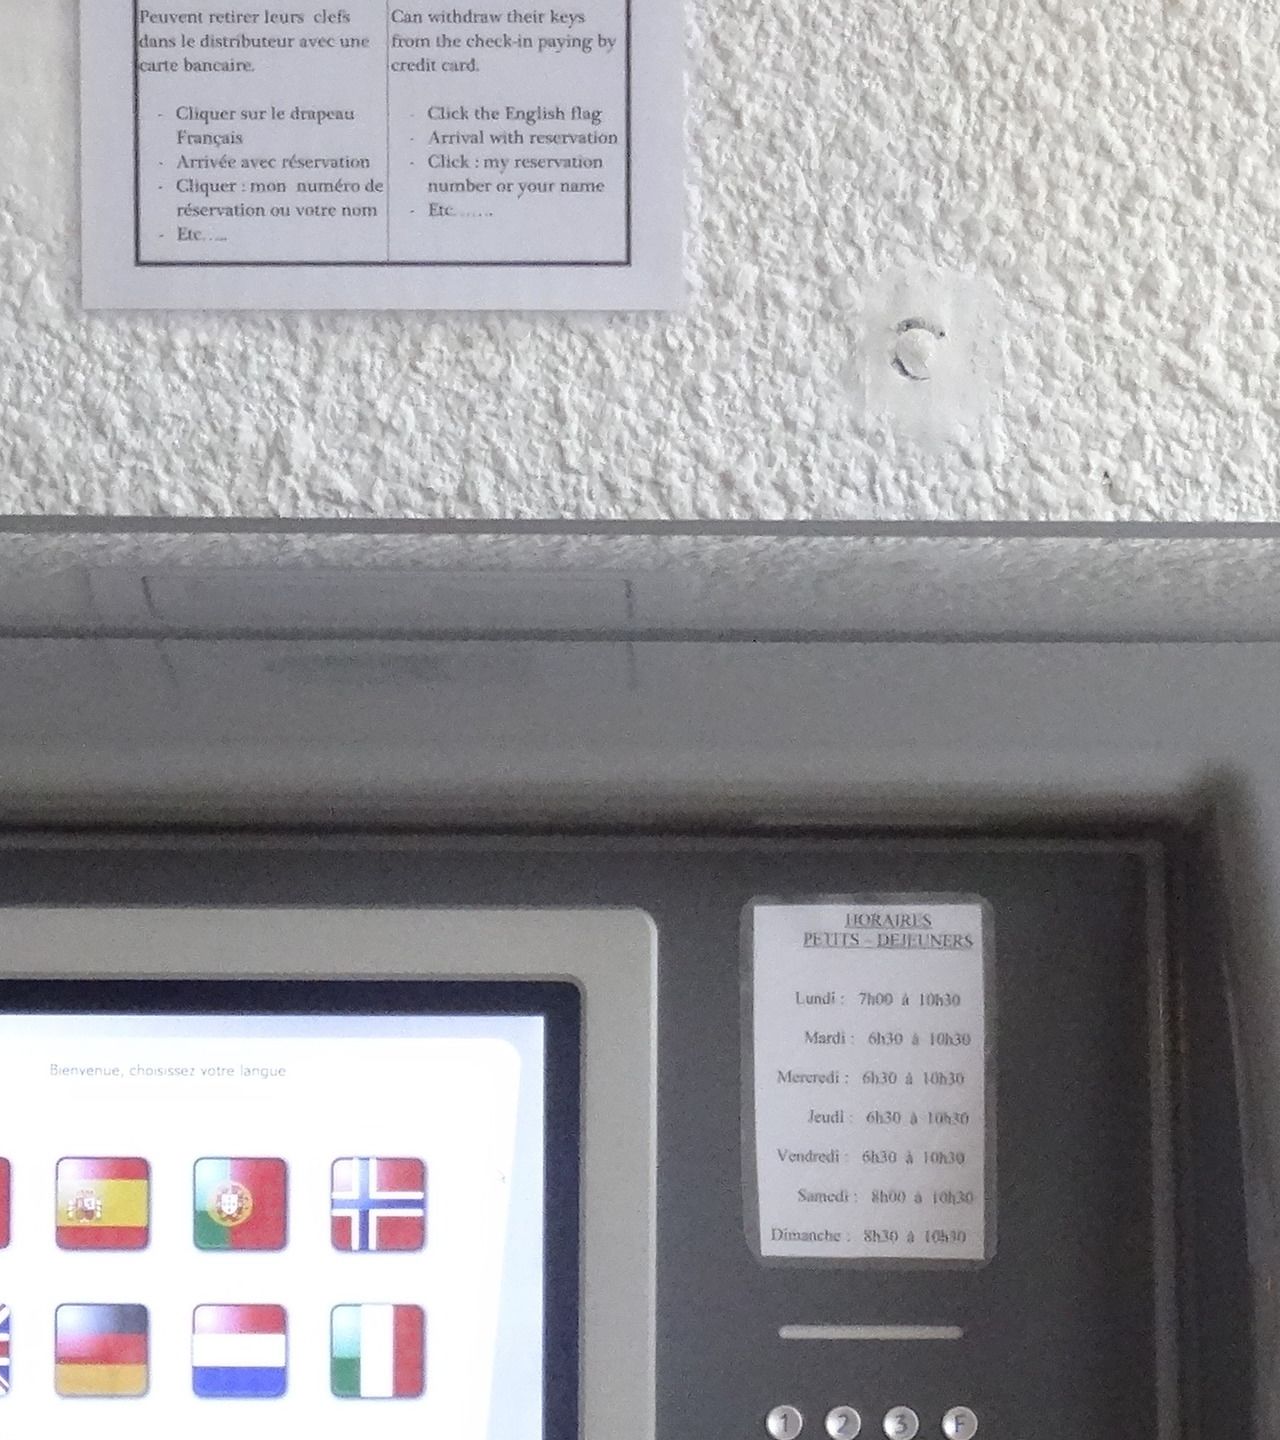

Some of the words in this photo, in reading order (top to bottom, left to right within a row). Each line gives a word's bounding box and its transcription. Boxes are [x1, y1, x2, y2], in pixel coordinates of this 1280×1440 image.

[139, 9, 203, 24] Peuvent
[209, 10, 259, 24] retirer
[265, 10, 305, 24] leurs
[313, 9, 351, 24] clefs
[391, 9, 422, 24] Can
[428, 9, 501, 24] withdraw
[507, 9, 545, 24] their
[550, 9, 586, 29] keys
[139, 34, 176, 49] dans
[181, 34, 195, 49] le
[200, 34, 295, 49] distributeur
[299, 37, 335, 49] avec
[339, 37, 370, 49] une
[391, 34, 431, 49] from
[436, 34, 461, 49] the
[466, 34, 533, 49] check-in
[538, 36, 593, 53] paying
[597, 34, 617, 54] by
[139, 60, 179, 73] carte
[183, 57, 255, 73] bancaire.
[390, 58, 436, 73] credit
[441, 58, 480, 73] card.
[176, 106, 236, 125] Cliquer
[240, 109, 267, 121] sur
[271, 106, 286, 121] le
[290, 106, 355, 125] drapeau
[427, 106, 469, 121] Click
[474, 106, 500, 121] the
[506, 106, 565, 126] English
[571, 106, 603, 126] flag
[176, 130, 243, 147] Français
[428, 130, 484, 145] Arrival
[489, 130, 525, 145] with
[529, 131, 618, 145] reservation
[176, 154, 237, 169] Arrivée
[240, 157, 277, 169] avec
[281, 154, 370, 169] réservation
[427, 154, 470, 169] Click
[483, 157, 508, 174] my
[514, 155, 604, 169] reservation
[176, 178, 237, 197] Cliquer
[249, 181, 287, 193] mon
[296, 179, 361, 193] numéro
[365, 178, 384, 193] de
[427, 178, 492, 193] number
[496, 181, 514, 193] or
[517, 181, 555, 200] your
[559, 181, 605, 193] name
[176, 203, 266, 217] réservation
[270, 205, 291, 217] ou
[295, 204, 337, 217] votre
[341, 205, 378, 217] nom
[845, 912, 933, 929] HORAIRES
[803, 931, 861, 948] PETITS
[795, 991, 837, 1006] Lundi
[804, 1030, 847, 1045] Mardi
[49, 1063, 124, 1079] Bienvenue,
[129, 1063, 196, 1077] choisissez
[200, 1064, 235, 1077] votre
[240, 1063, 287, 1080] langue
[777, 1070, 841, 1085] Mercredi
[808, 1109, 845, 1124] Jeudi
[776, 1149, 841, 1164] Vendredi
[797, 1189, 850, 1204] Samedi
[771, 1228, 842, 1243] Dimanche
[836, 1414, 850, 1434] 2
[894, 1413, 908, 1434] 3
